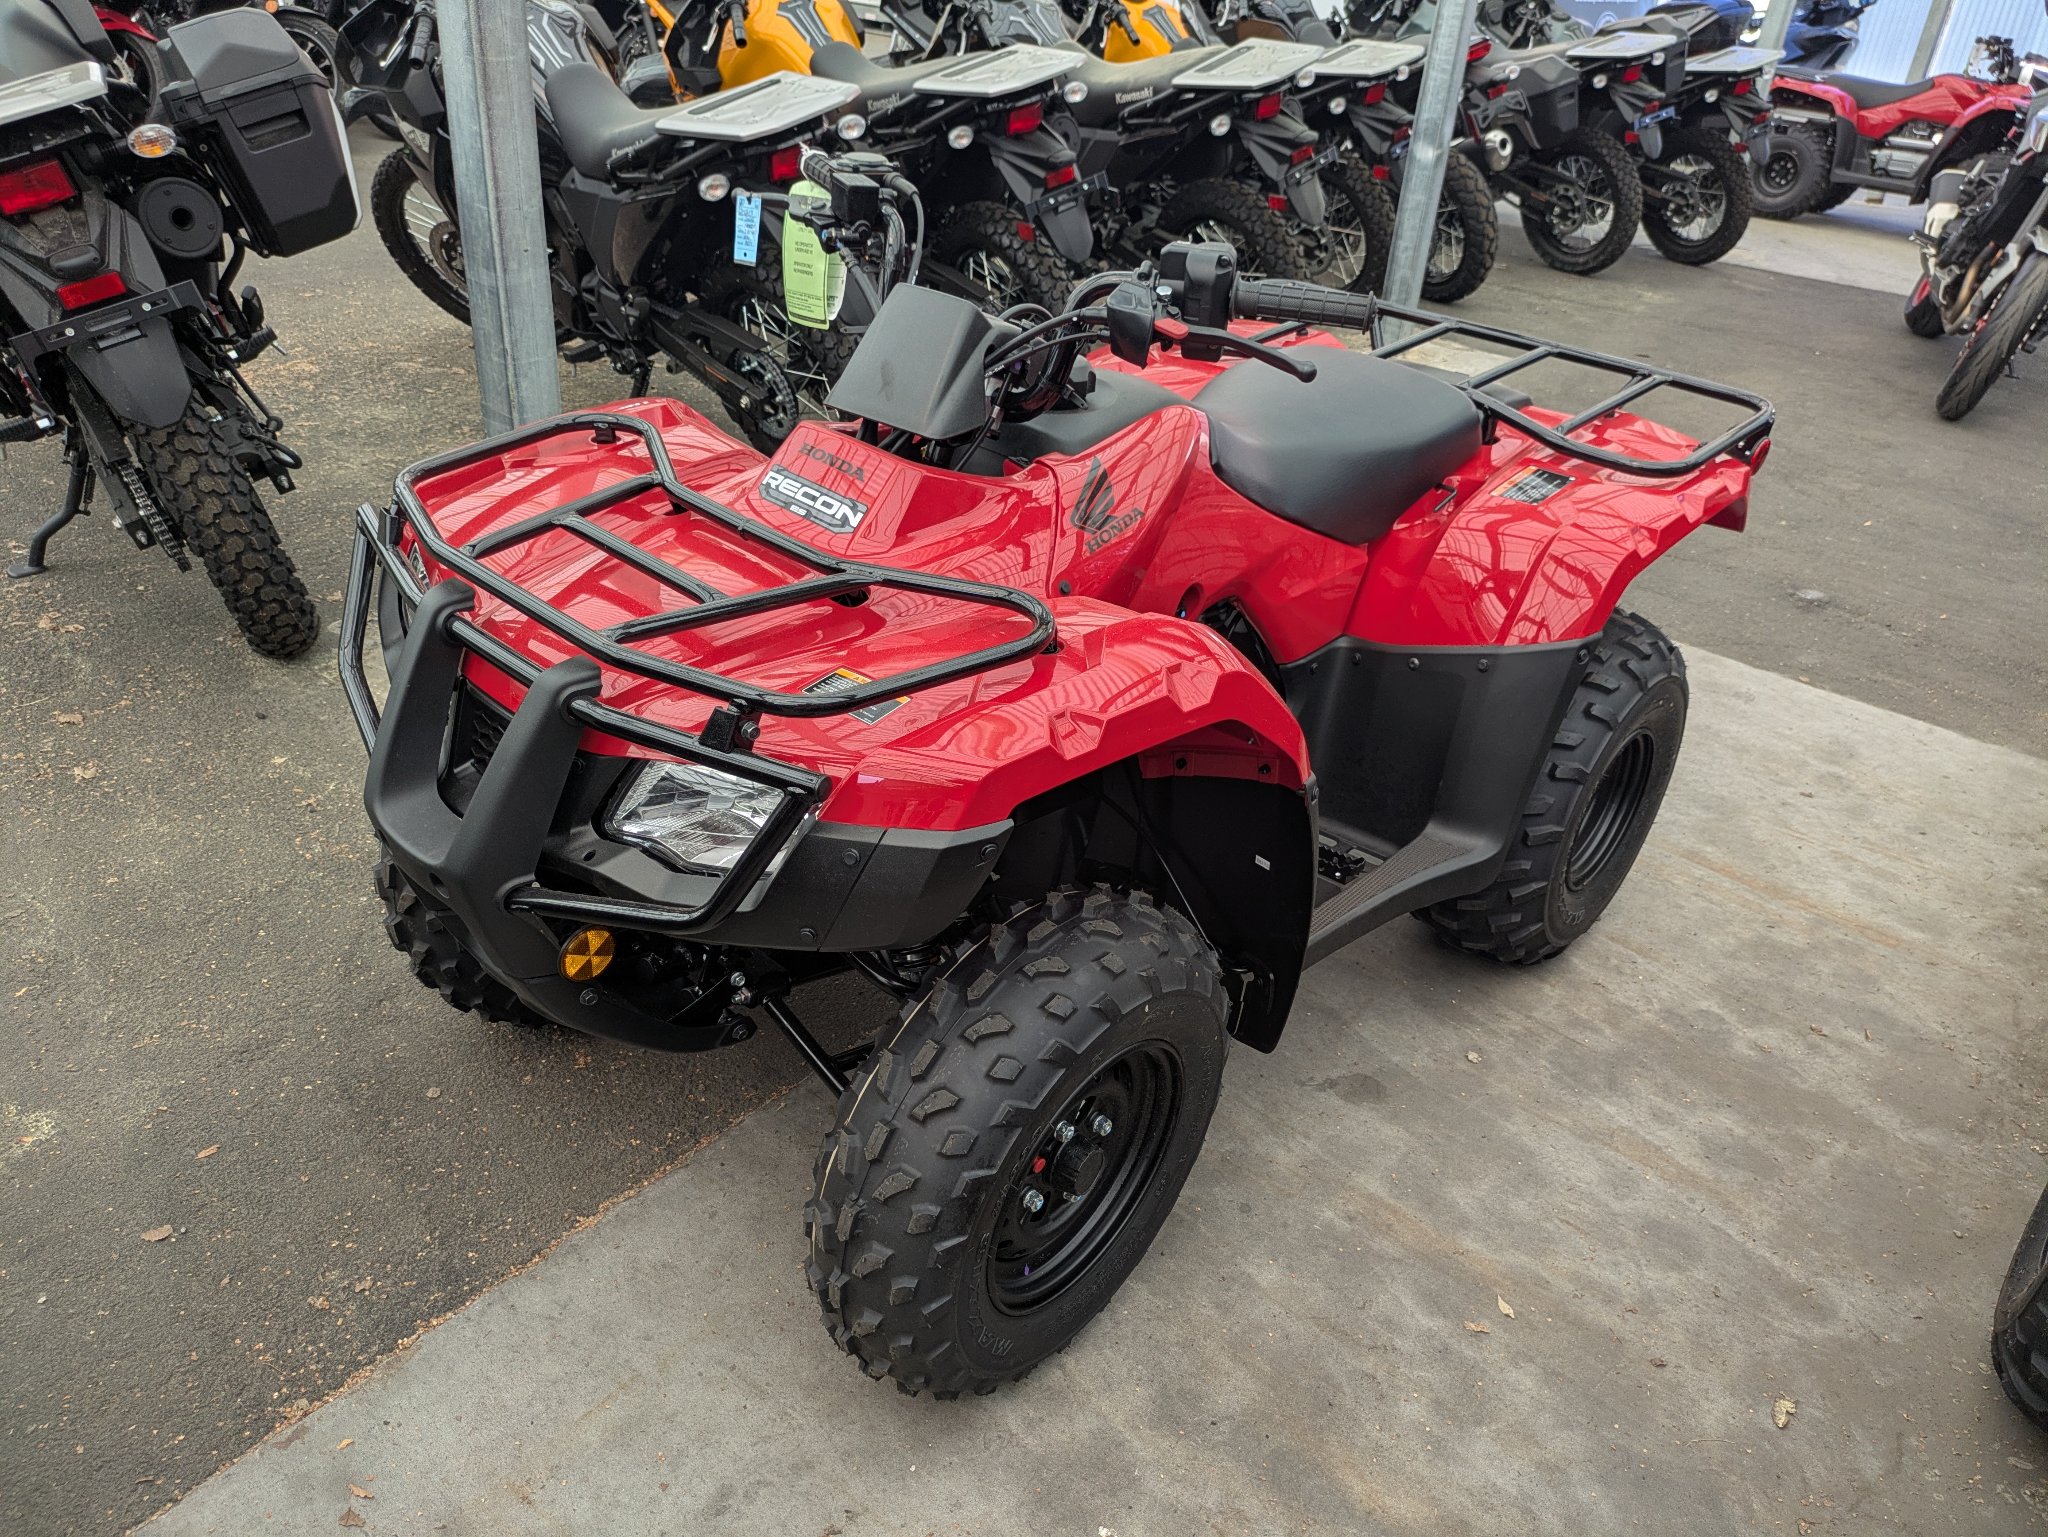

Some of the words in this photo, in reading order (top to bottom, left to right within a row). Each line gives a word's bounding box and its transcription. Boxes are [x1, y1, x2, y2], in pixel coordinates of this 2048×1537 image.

[1115, 86, 1153, 105] Kawasaki
[799, 442, 865, 482] HONDA
[762, 470, 864, 528] RECON
[1085, 507, 1146, 553] HONDA
